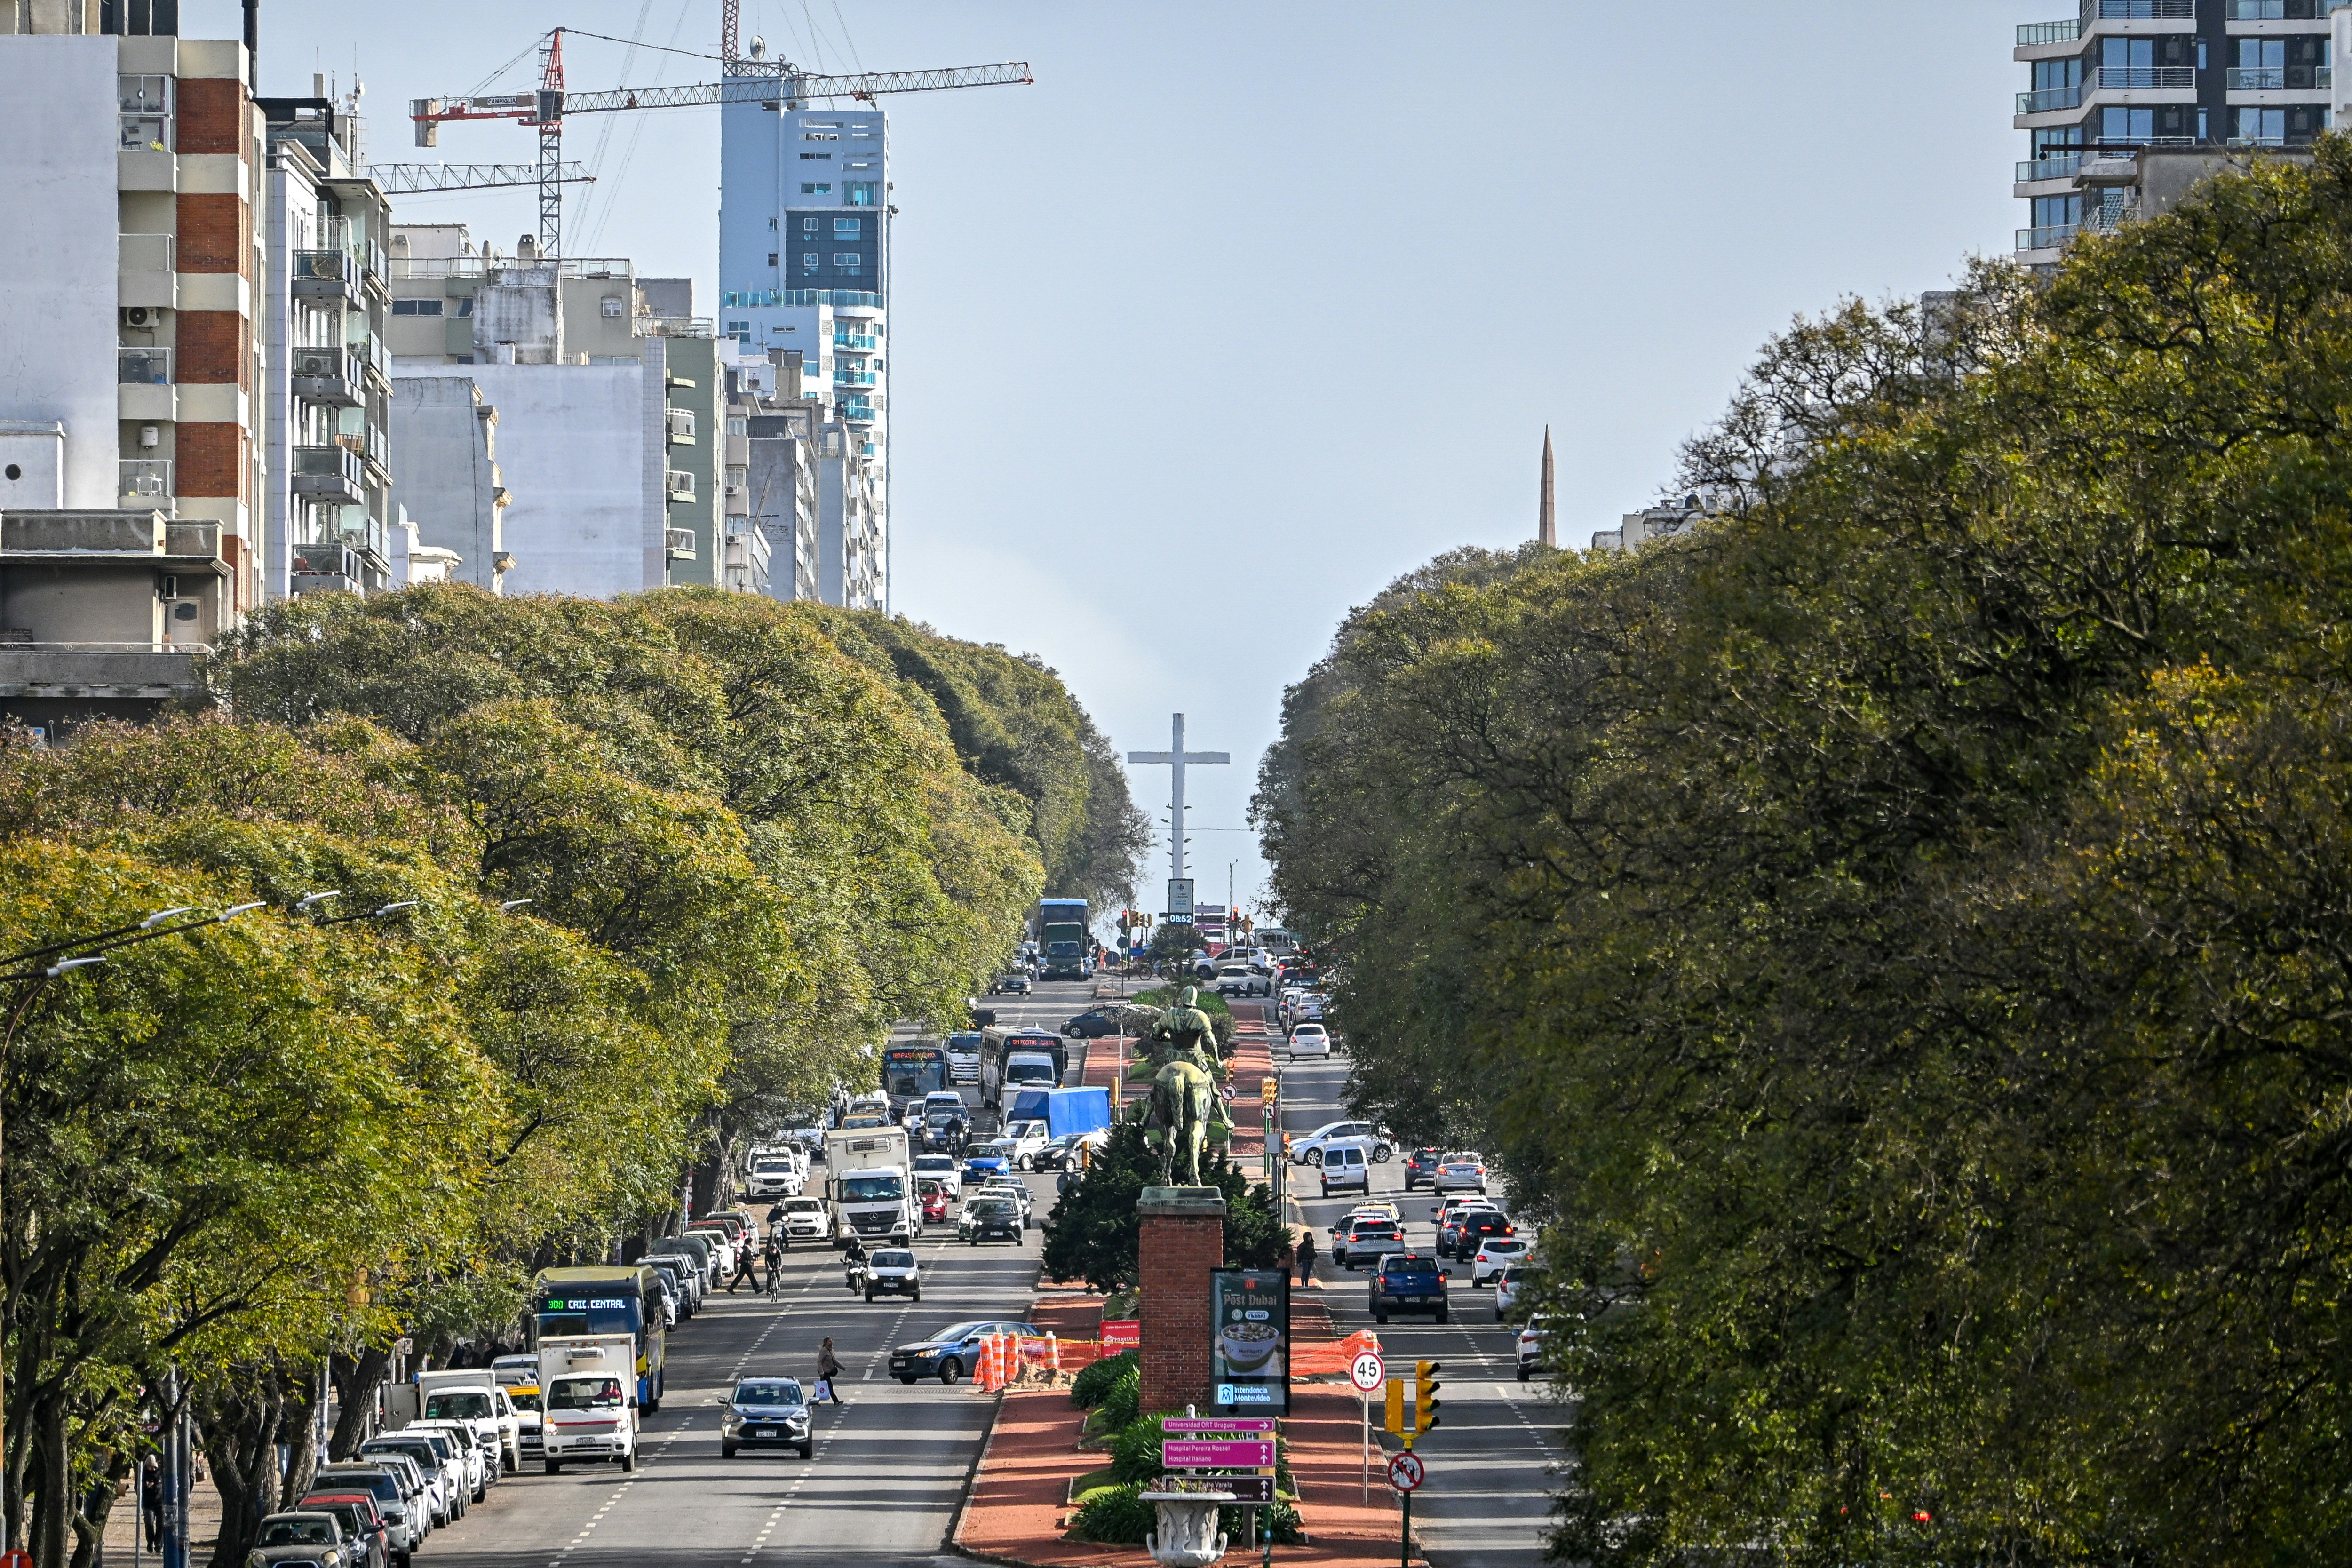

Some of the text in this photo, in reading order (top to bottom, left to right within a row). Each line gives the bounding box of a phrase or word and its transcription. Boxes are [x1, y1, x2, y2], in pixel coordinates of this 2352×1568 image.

[1170, 915, 1192, 923] 08:52
[1224, 1294, 1277, 1305] Post Dubai
[1358, 1362, 1377, 1377] 45
